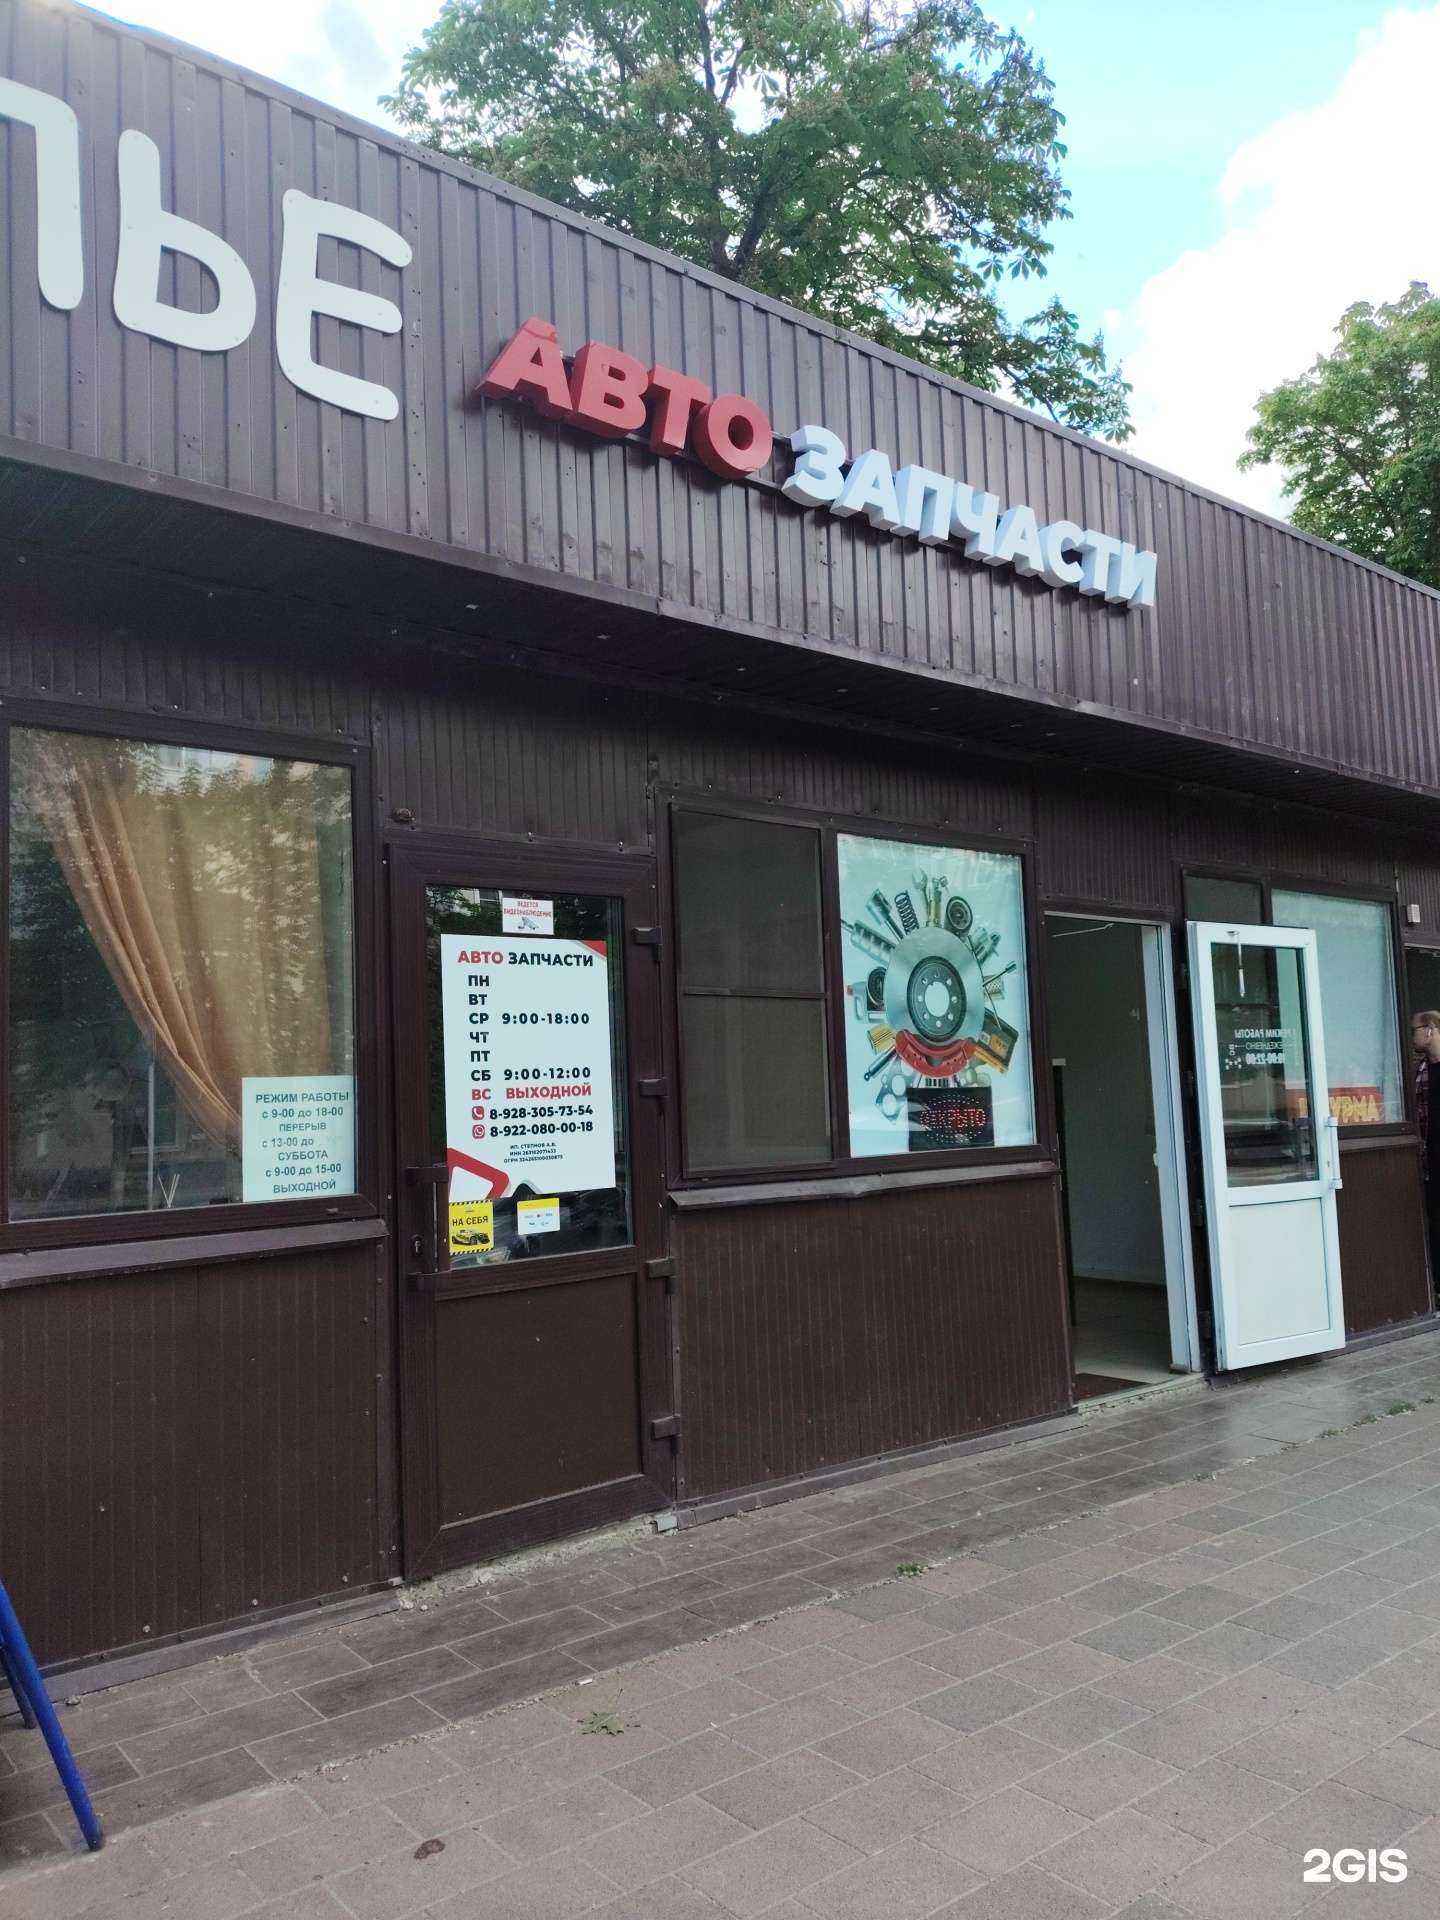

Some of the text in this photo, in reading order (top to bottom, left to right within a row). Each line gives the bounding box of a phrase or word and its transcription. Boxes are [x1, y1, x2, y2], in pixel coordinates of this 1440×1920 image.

[477, 316, 1157, 609] АВТО ЗАПЧАСТИ
[458, 951, 593, 967] АВТО ЗАПЧАСТИ
[468, 975, 490, 987] ПН
[468, 994, 488, 1005] ВТ
[469, 1012, 590, 1024] СР 9:00-18:00
[469, 1031, 490, 1043] ЧТ
[470, 1050, 490, 1062] ПТ
[471, 1067, 591, 1081] СБ 9:00-12:00
[472, 1082, 592, 1100] ВС ВЫХОДНОЙ
[255, 1092, 349, 1103] РЕЖИМ РАБОТЫ
[262, 1107, 344, 1119] с 9-00 до 18-00
[489, 1104, 593, 1120] 8-928-305-73-54
[279, 1122, 327, 1132] ПЕРЕРЫВ
[490, 1121, 593, 1137] 8-922-080-00-18
[272, 1137, 298, 1147] 13-00
[301, 1138, 314, 1147] до
[278, 1151, 328, 1161] СУББОТА
[274, 1167, 296, 1176] 9-00
[299, 1168, 312, 1176] до
[316, 1163, 342, 1173] 15-00
[273, 1179, 336, 1193] ВЫХОДНОЙ
[452, 1216, 488, 1226] НА СЕБЯ
